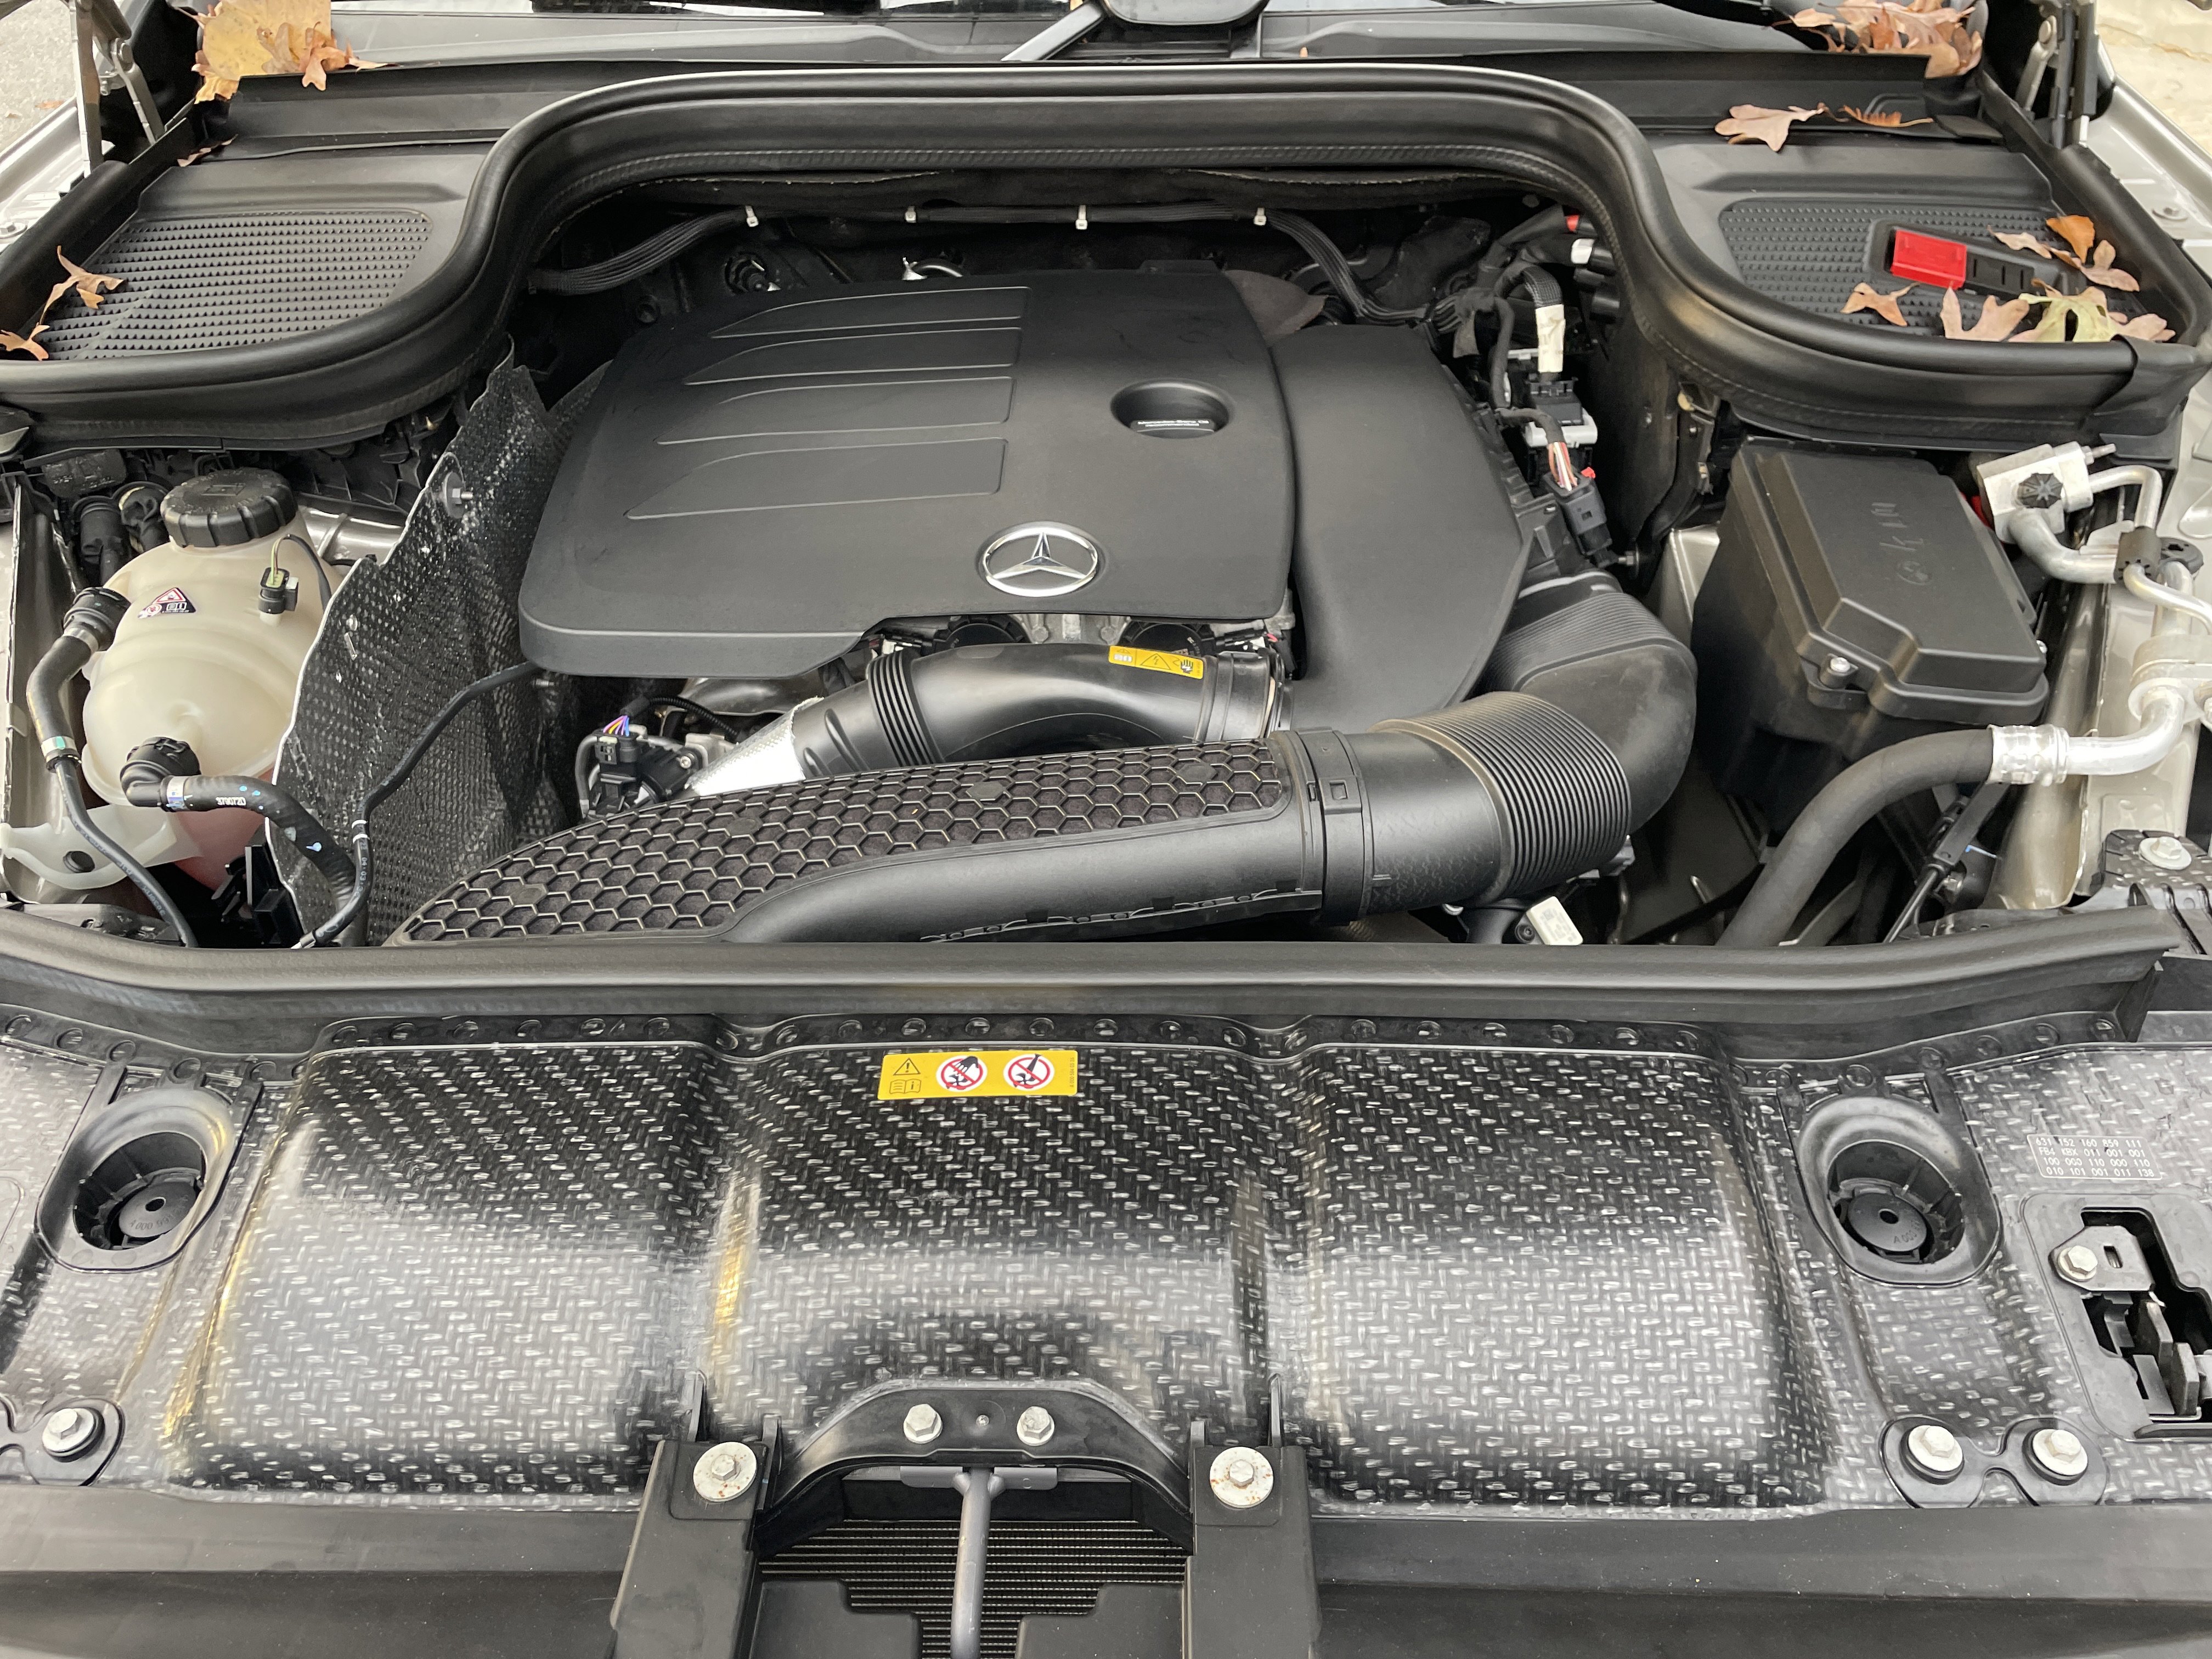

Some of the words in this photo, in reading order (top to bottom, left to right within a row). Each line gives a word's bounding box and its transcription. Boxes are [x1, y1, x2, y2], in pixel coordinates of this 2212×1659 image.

[2036, 1137, 2052, 1146] 631
[2058, 1138, 2075, 1147] 152
[2081, 1138, 2097, 1147] 160
[2102, 1139, 2119, 1148] 859
[2125, 1139, 2142, 1148] 111
[2038, 1147, 2055, 1155] FB4
[2084, 1148, 2101, 1157] 011
[2106, 1149, 2123, 1158] 001
[2128, 1149, 2146, 1158] 001
[2043, 1156, 2060, 1166] 100
[2064, 1158, 2083, 1166] 000
[2088, 1158, 2105, 1166] 110
[2110, 1158, 2128, 1167] 000
[2134, 1159, 2151, 1167] 110
[2046, 1166, 2064, 1175] 010
[2070, 1167, 2086, 1176] 101
[2091, 1167, 2108, 1176] 001
[2114, 1168, 2131, 1177] 011
[2138, 1169, 2154, 1177] 138
